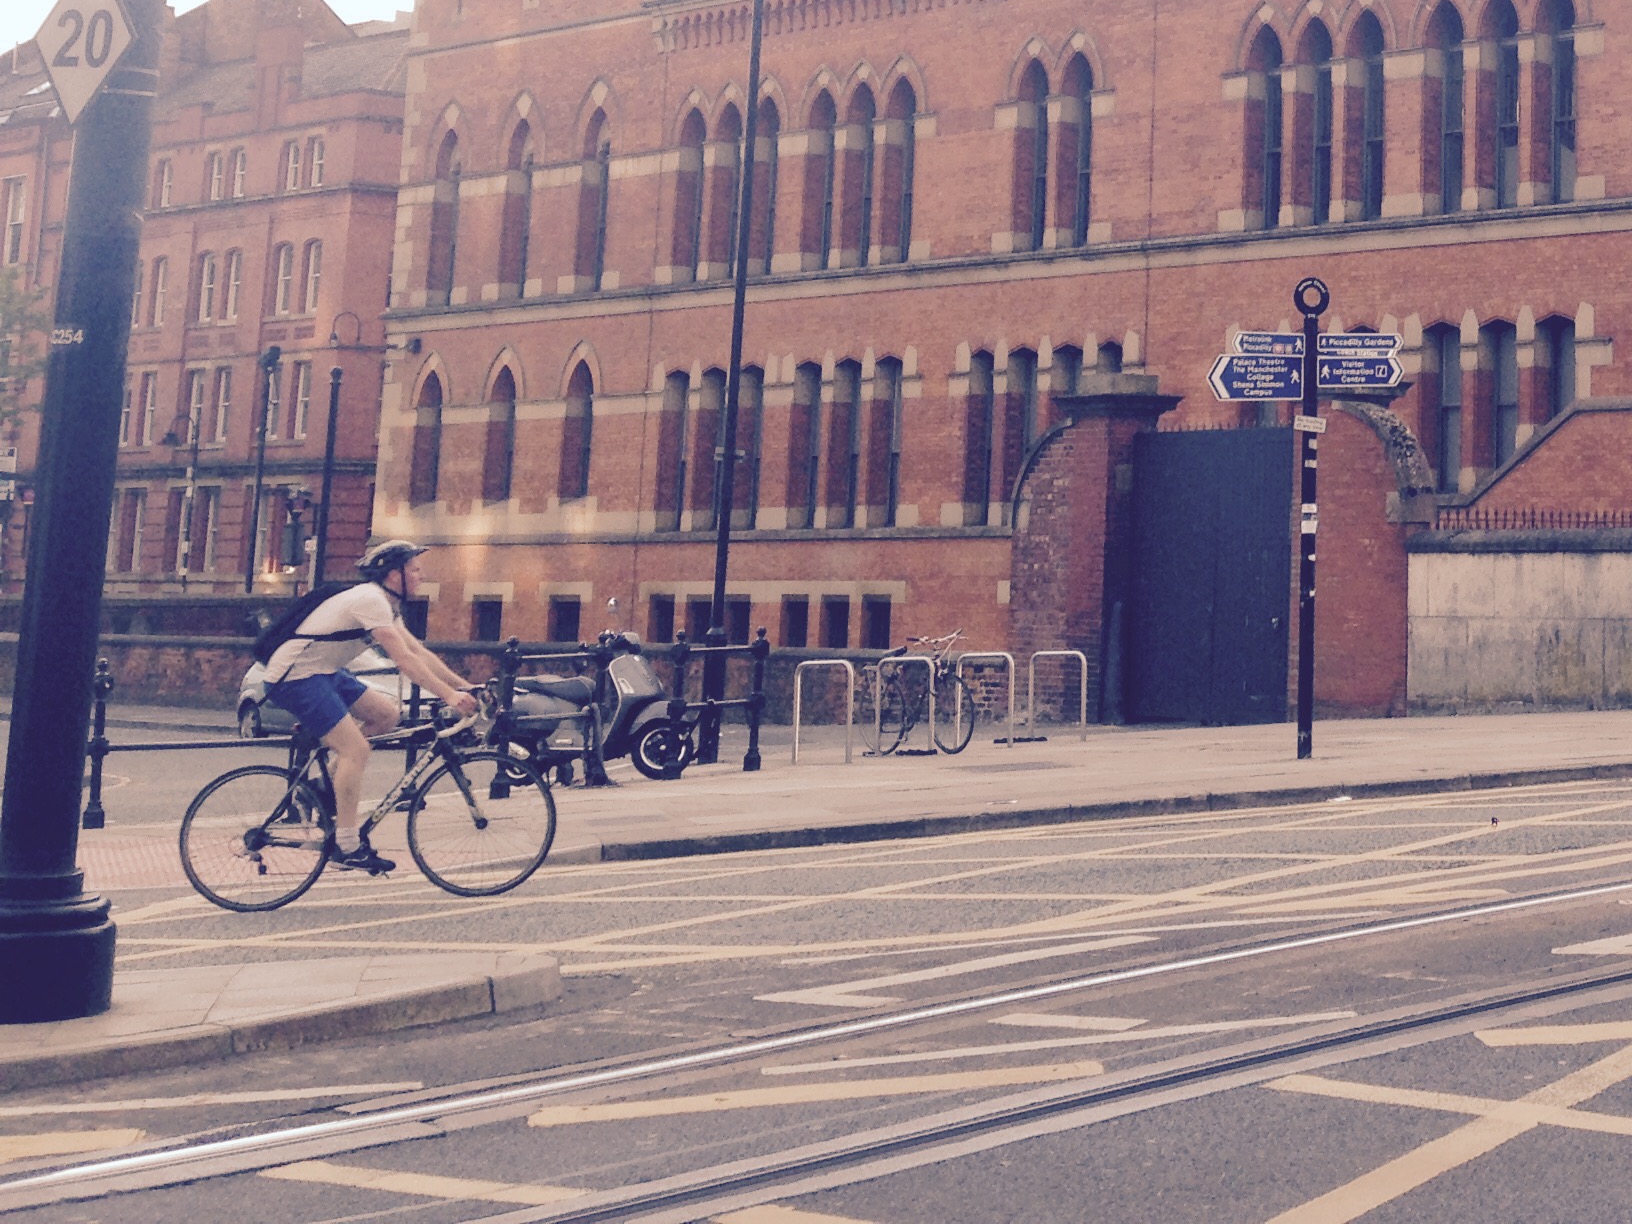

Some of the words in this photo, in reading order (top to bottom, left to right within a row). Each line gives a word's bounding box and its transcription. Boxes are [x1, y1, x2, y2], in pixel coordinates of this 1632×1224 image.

[52, 8, 114, 68] 20
[1329, 337, 1362, 346] Piccadilly
[1364, 337, 1394, 346] Gardens
[1242, 342, 1272, 352] Piccadilly
[1232, 358, 1257, 366] Palace
[1259, 357, 1286, 366] Theatre
[1341, 360, 1365, 368] Visitor
[1233, 366, 1246, 374] The
[1247, 366, 1289, 374] Manchester
[1332, 367, 1375, 376] Information
[1246, 373, 1275, 382] College
[1340, 376, 1366, 384] Centre
[1243, 388, 1273, 397] Campus
